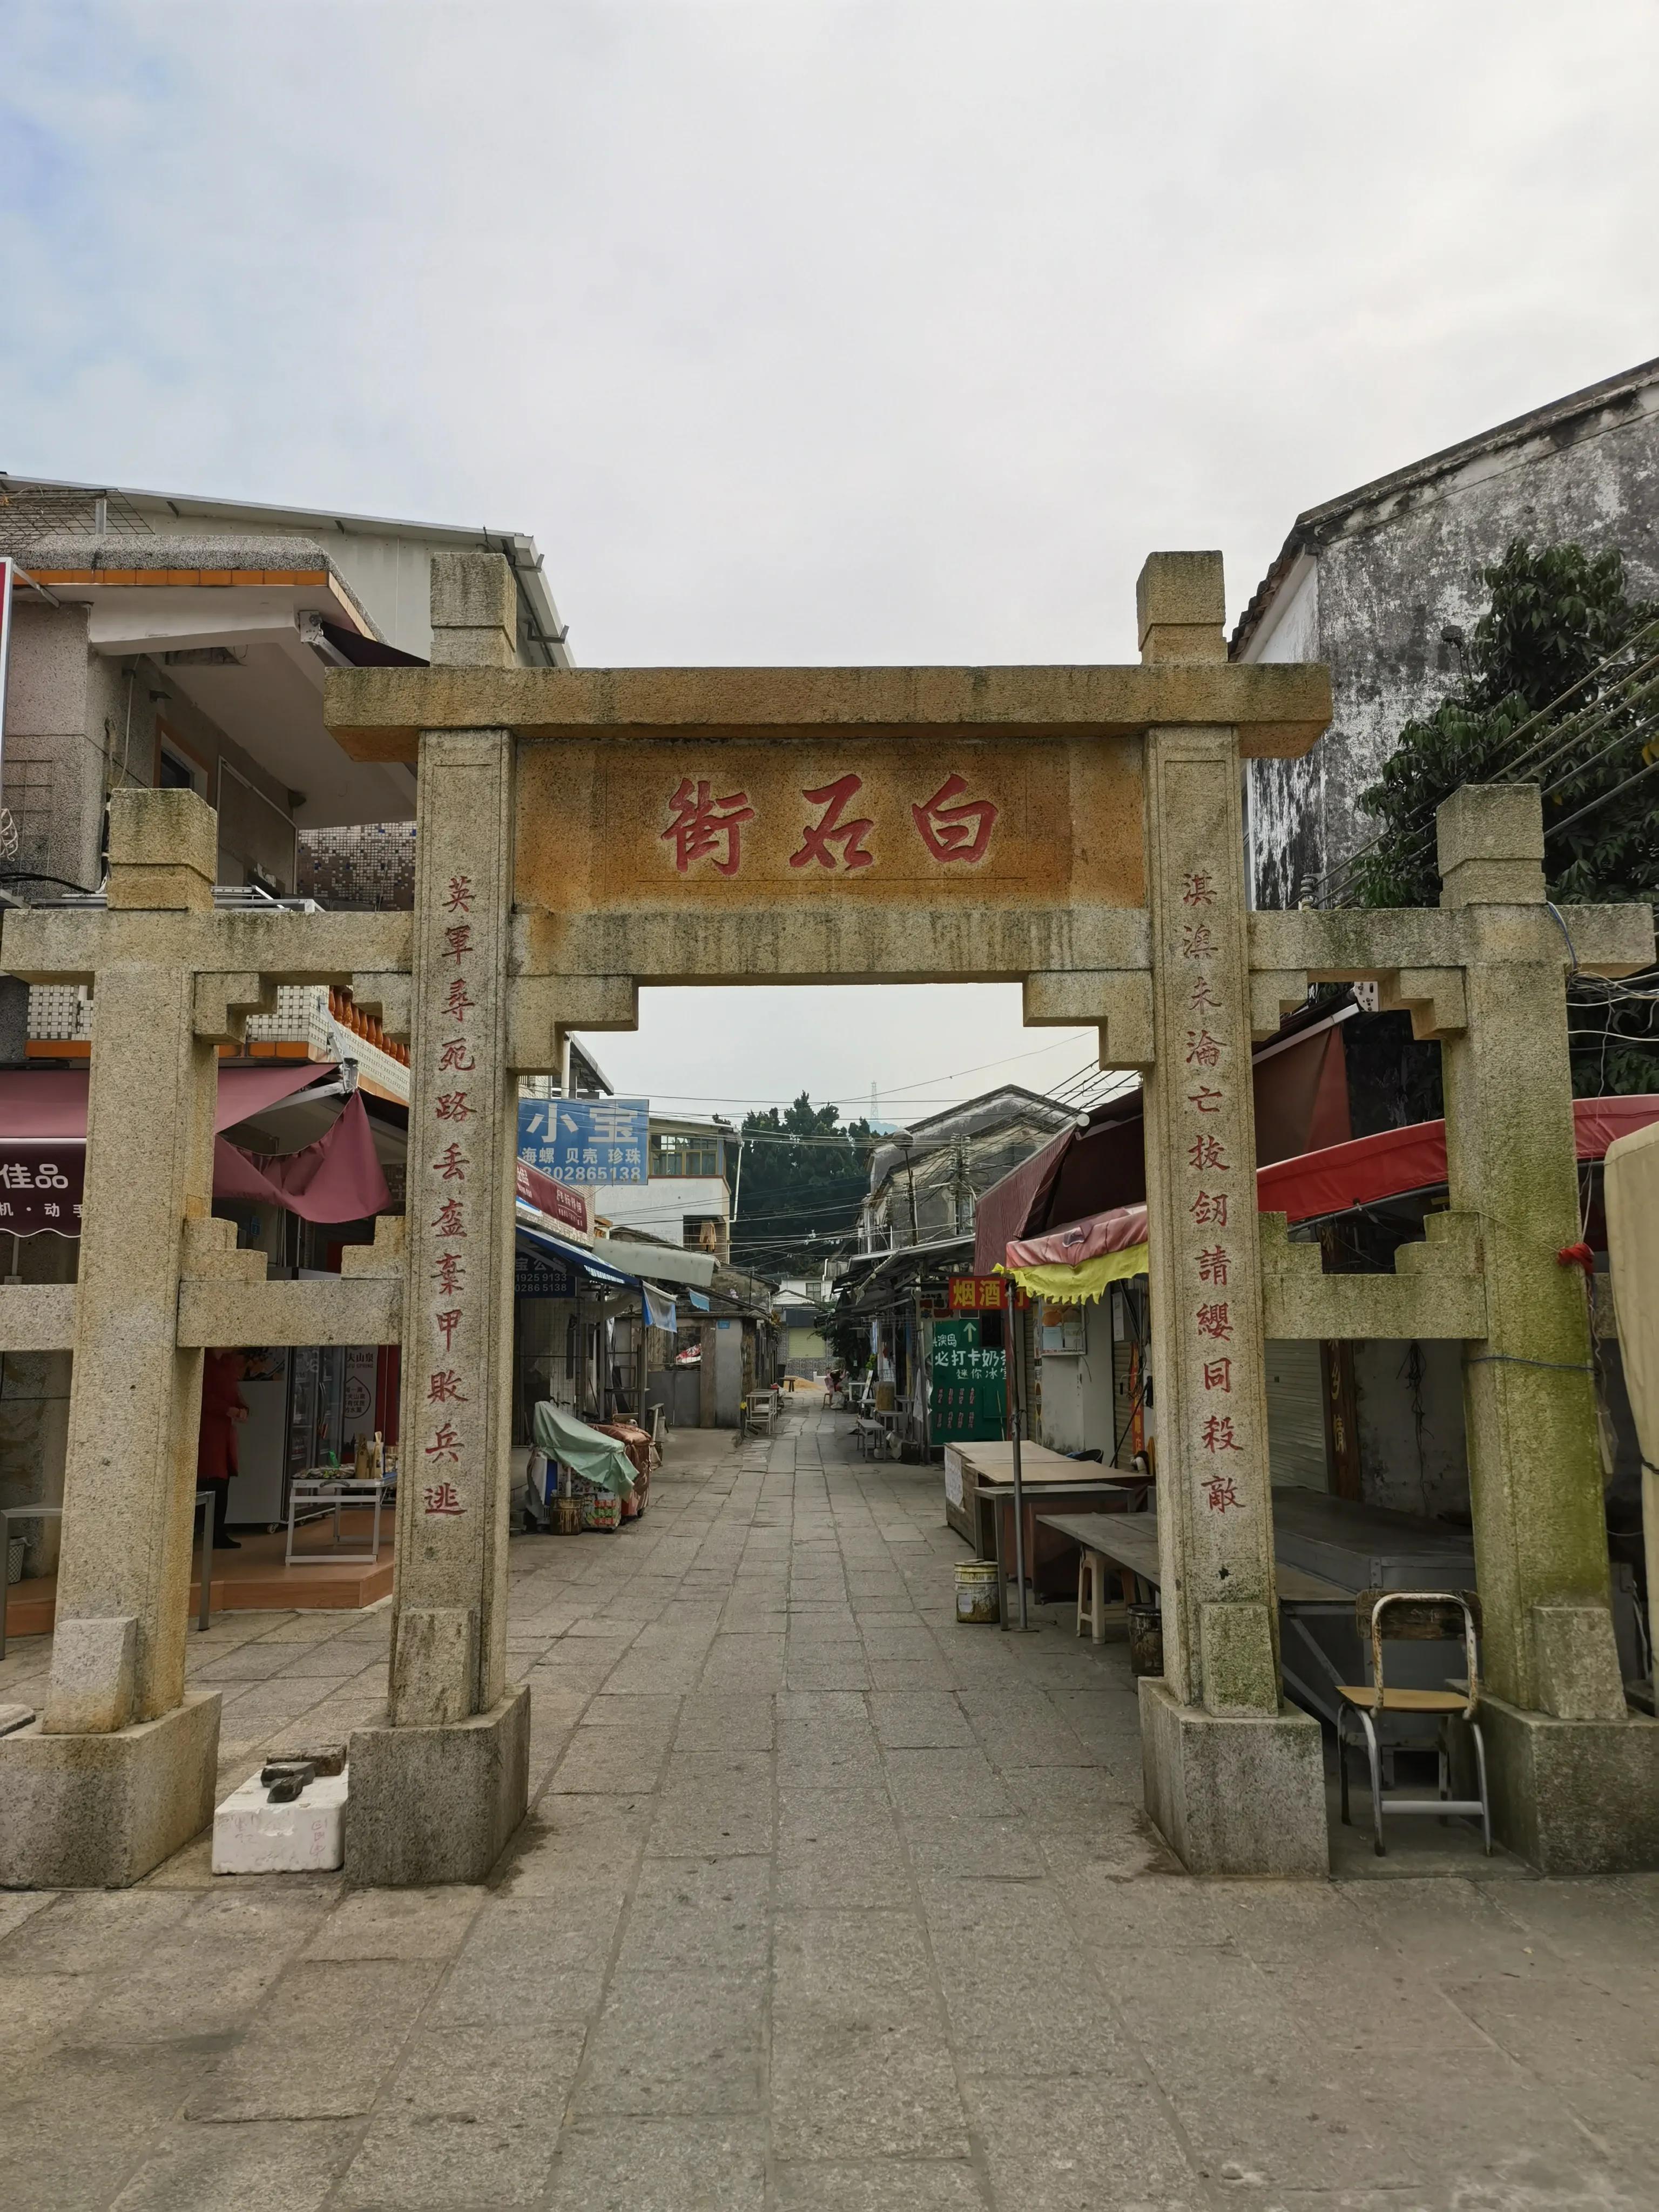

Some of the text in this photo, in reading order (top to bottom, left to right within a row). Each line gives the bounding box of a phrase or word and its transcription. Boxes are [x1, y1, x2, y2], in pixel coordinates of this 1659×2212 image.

[661, 773, 998, 876] 白石街
[526, 1103, 638, 1143] 小宝
[522, 1147, 641, 1164] 海螺 贝壳 珍珠
[0, 1163, 69, 1189] 佳品
[516, 1258, 567, 1273] 宝公
[542, 1284, 567, 1292] 5138
